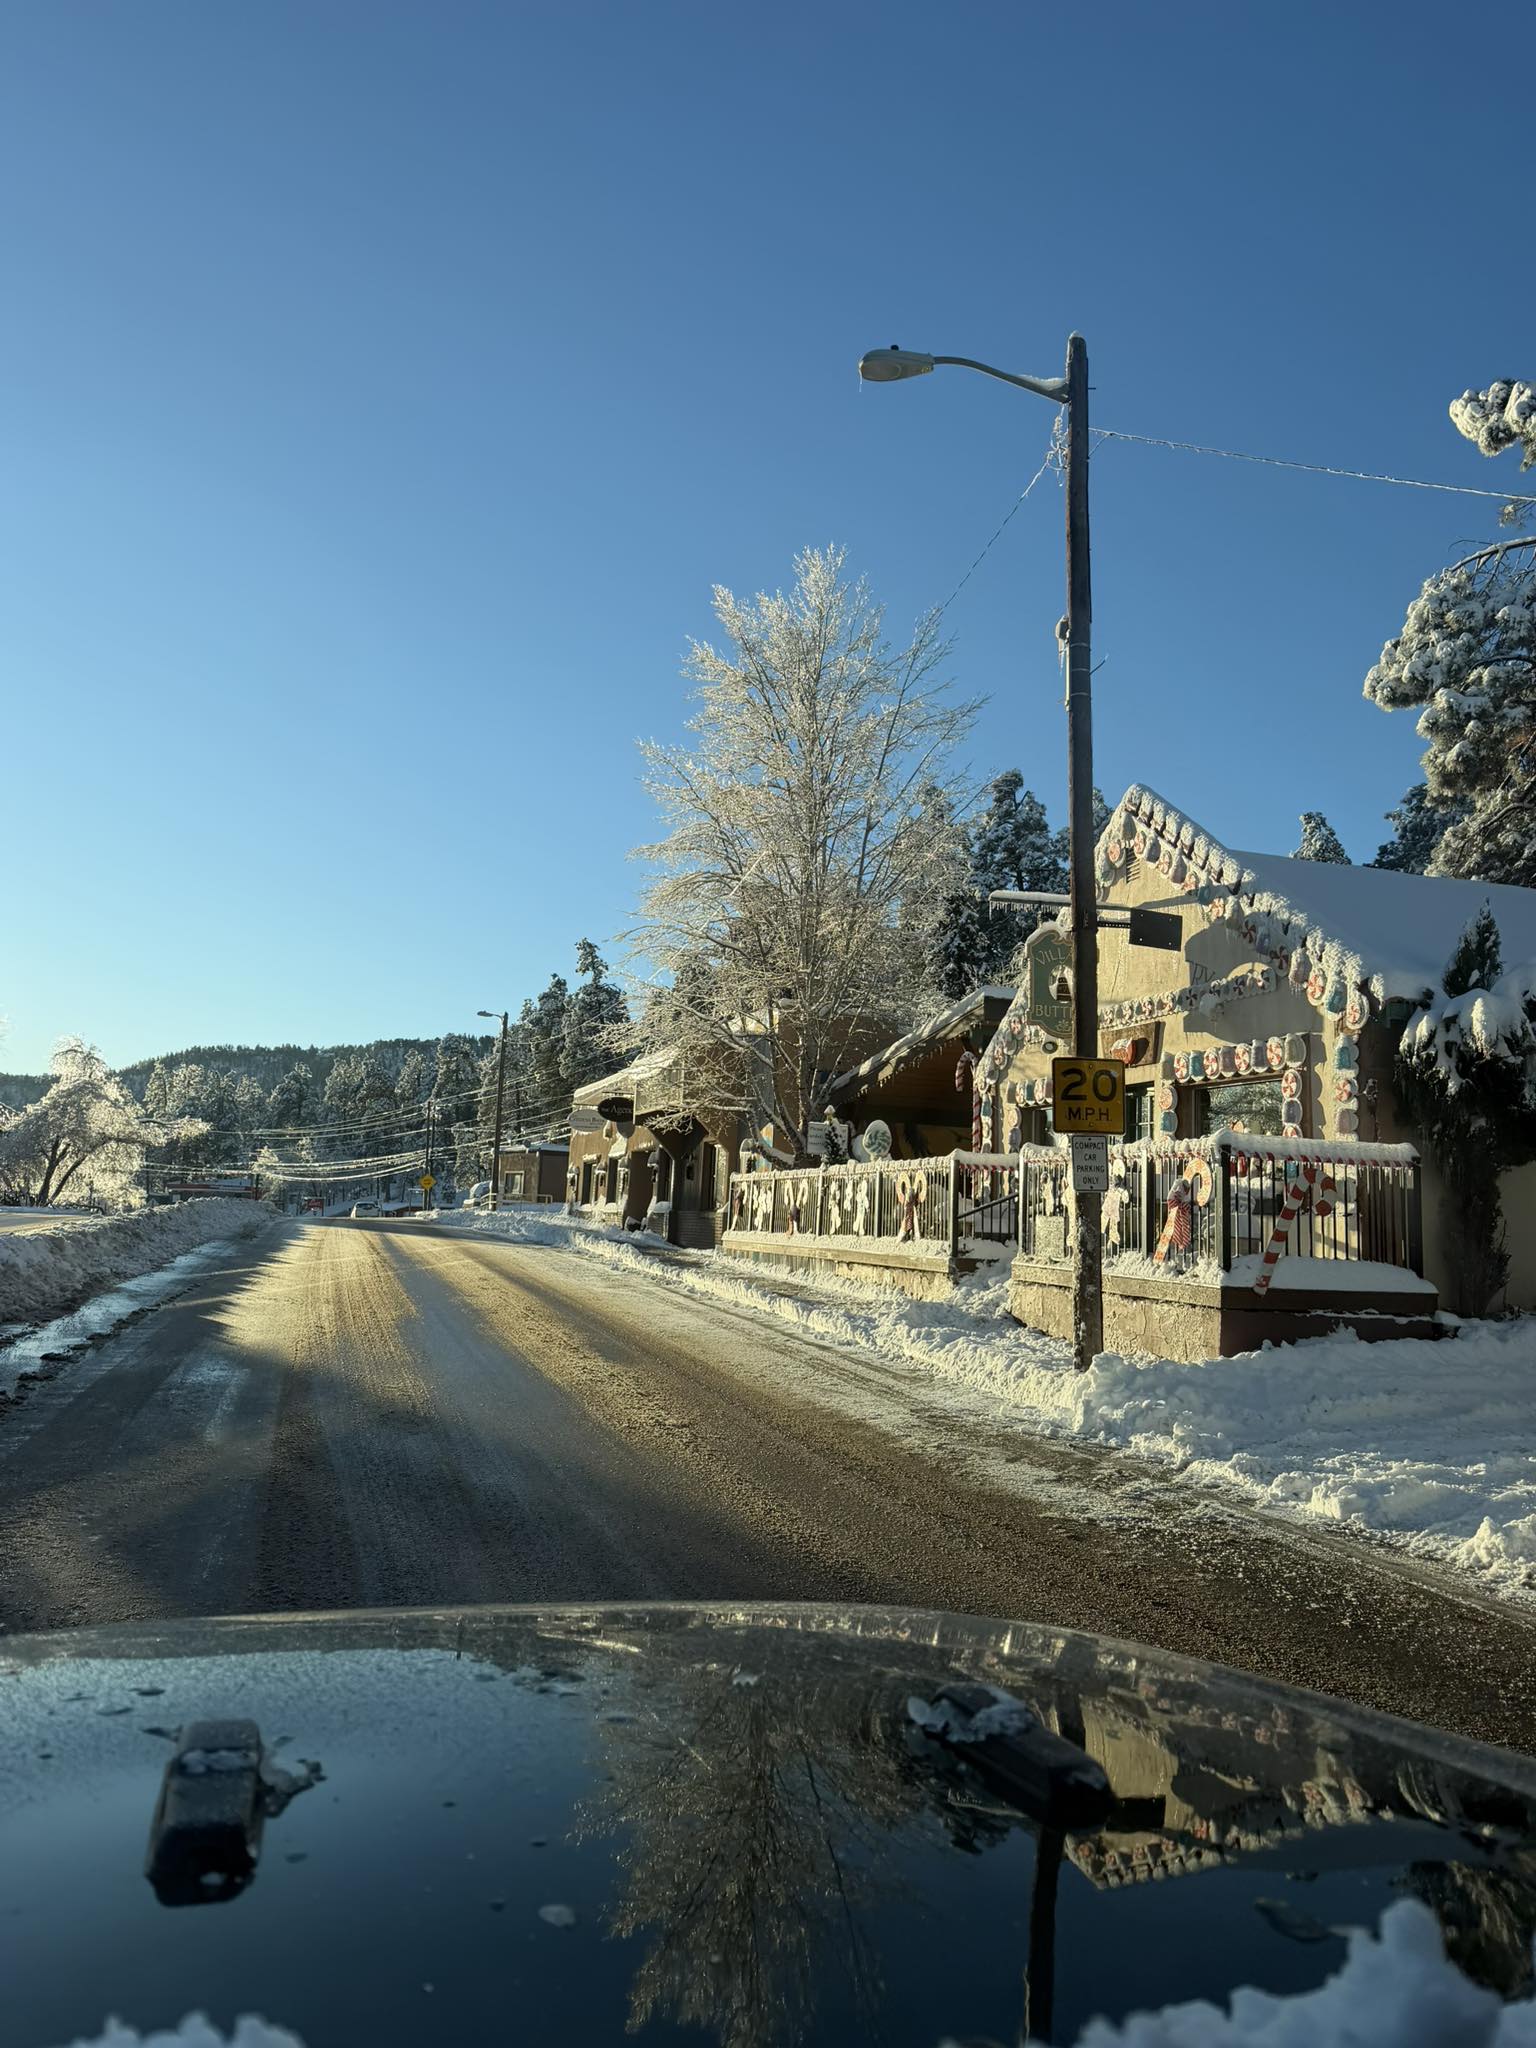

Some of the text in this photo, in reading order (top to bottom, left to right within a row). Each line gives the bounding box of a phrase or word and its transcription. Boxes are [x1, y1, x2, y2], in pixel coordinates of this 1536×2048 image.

[1035, 1004, 1072, 1018] BUTT
[1061, 1068, 1117, 1102] 20
[1075, 1142, 1104, 1150] COMPACT
[1084, 1153, 1096, 1161] CAR
[1076, 1165, 1104, 1173] PARKING
[1082, 1176, 1099, 1185] ONLY
